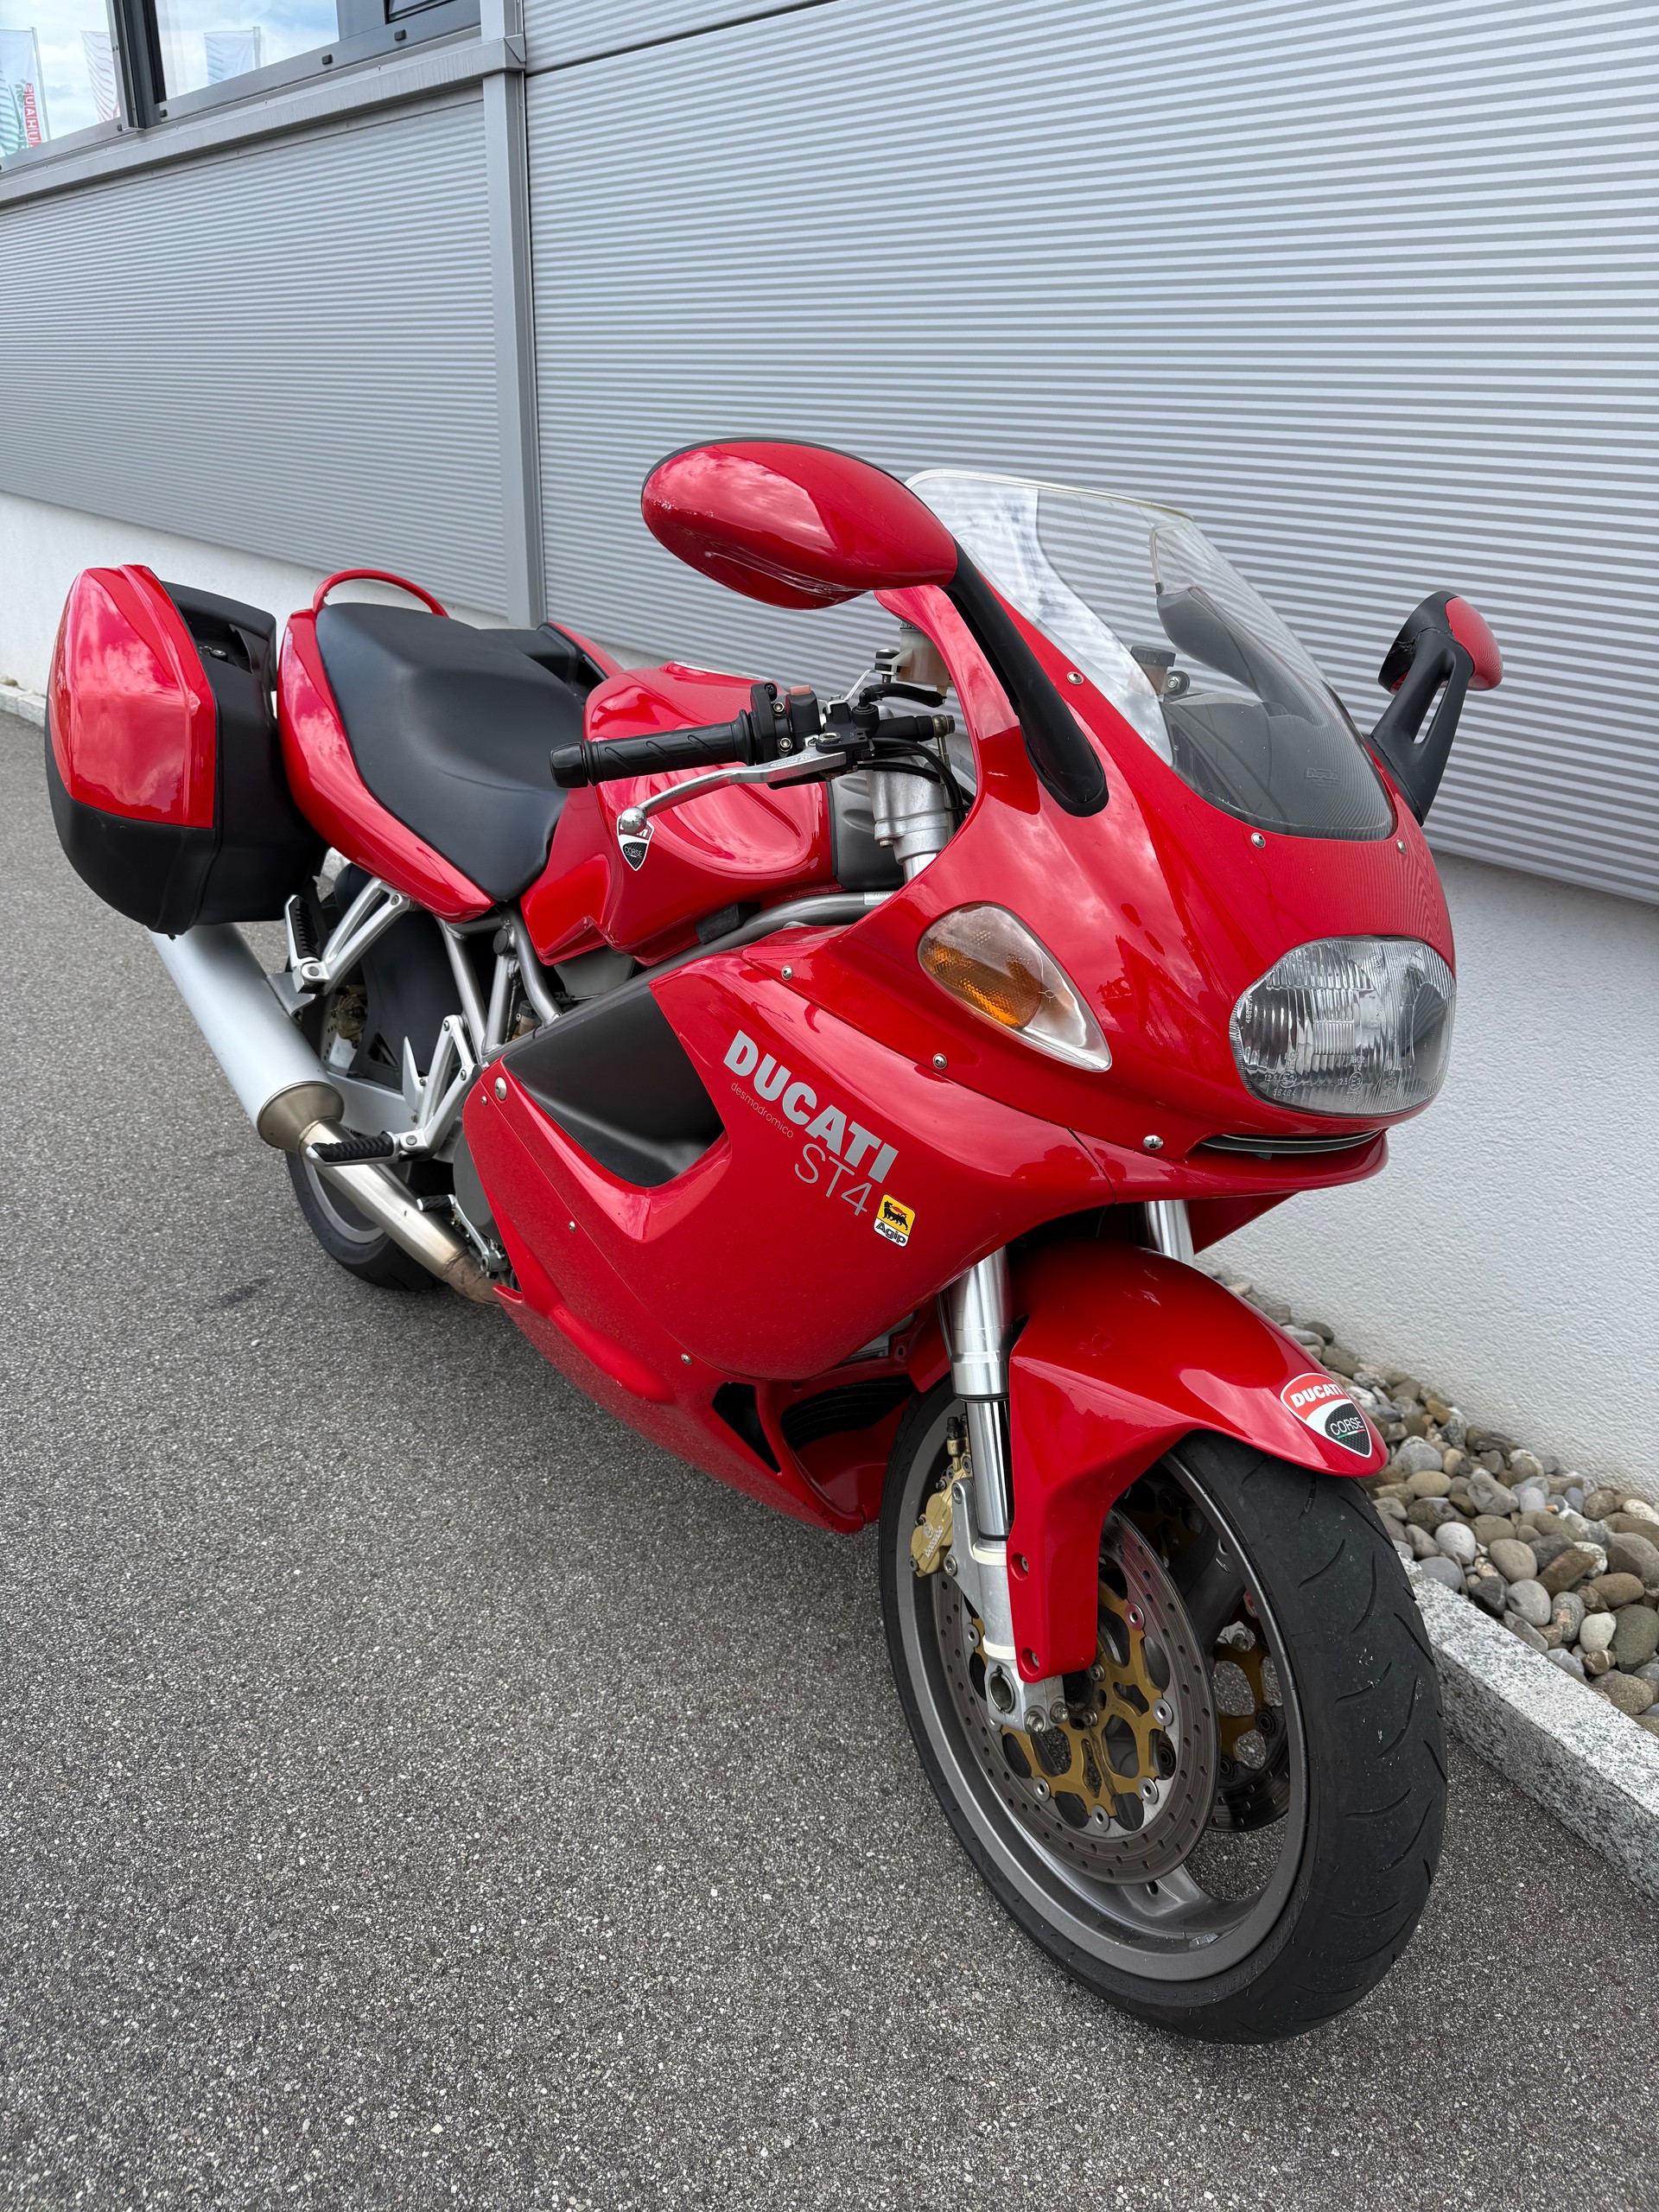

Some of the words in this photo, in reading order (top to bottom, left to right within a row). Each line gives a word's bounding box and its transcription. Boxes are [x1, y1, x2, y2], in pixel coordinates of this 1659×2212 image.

[723, 1030, 899, 1184] DUCATI
[731, 1083, 793, 1138] desmodromico
[795, 1143, 873, 1216] ST4
[875, 1221, 906, 1244] Agip
[1290, 1383, 1344, 1408] DUCATI
[1330, 1417, 1364, 1435] CORSE
